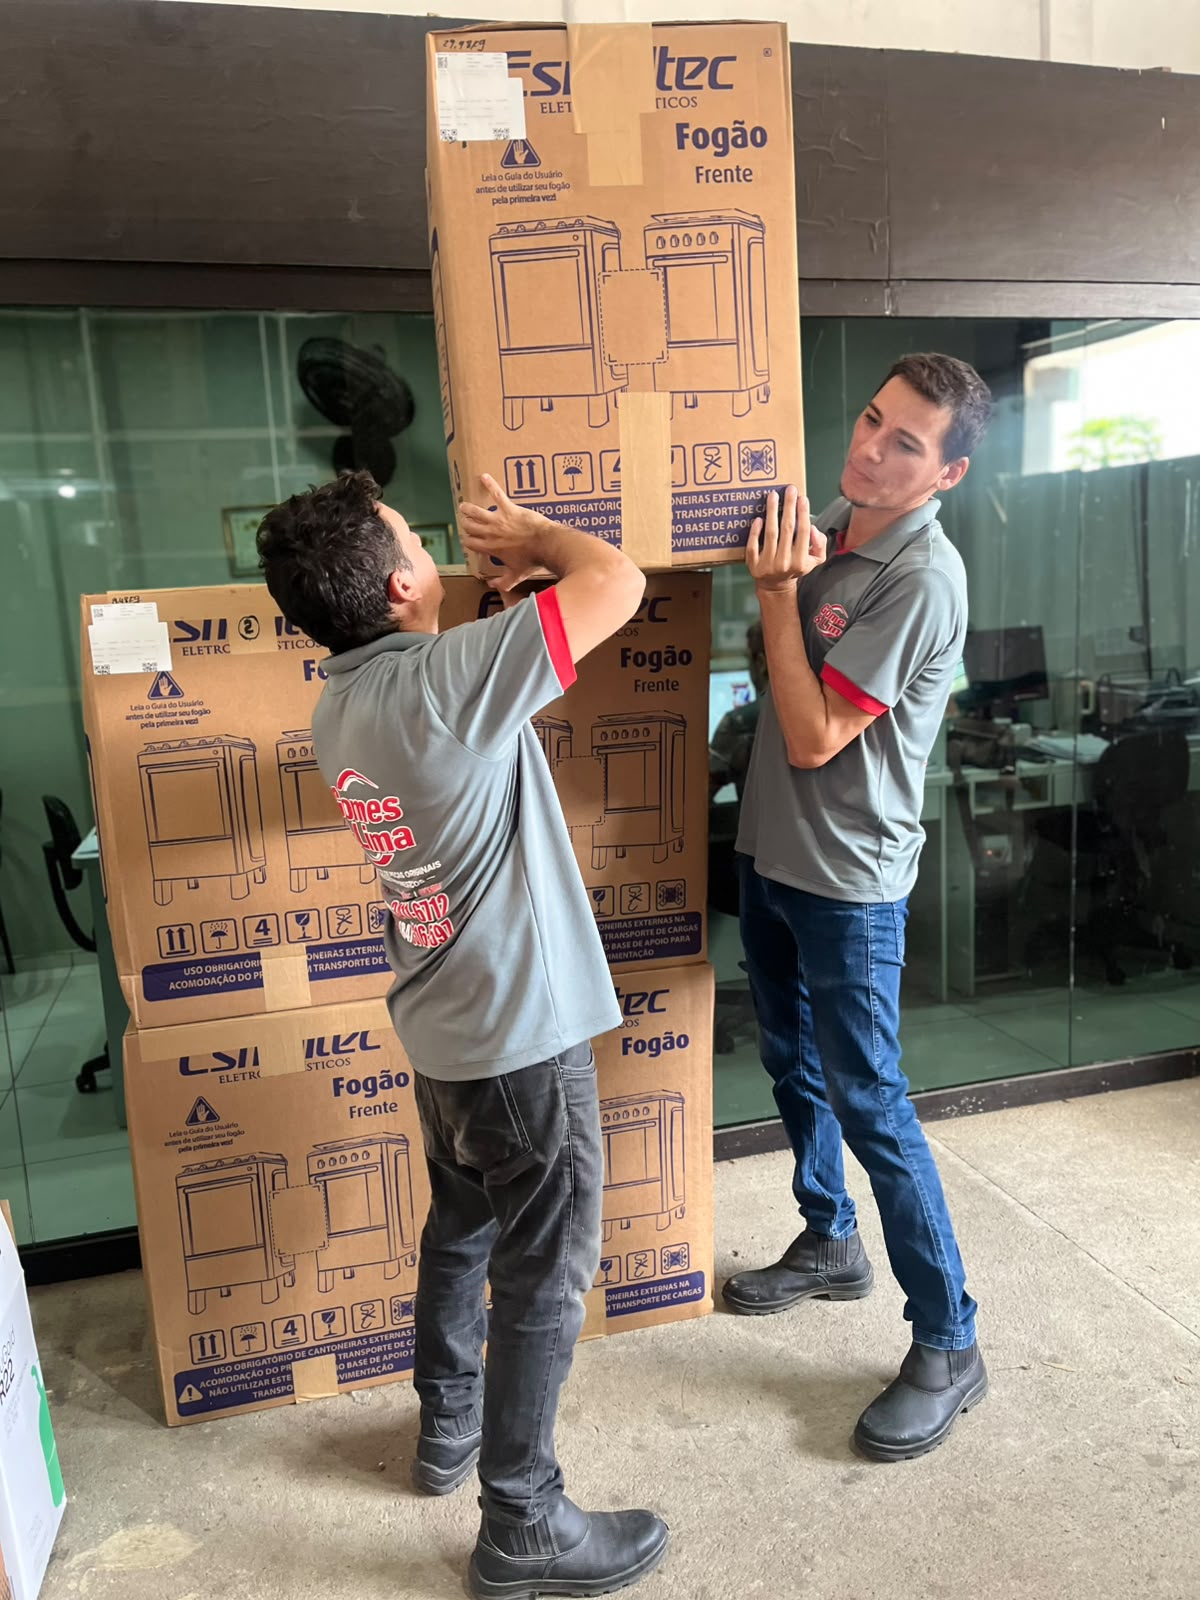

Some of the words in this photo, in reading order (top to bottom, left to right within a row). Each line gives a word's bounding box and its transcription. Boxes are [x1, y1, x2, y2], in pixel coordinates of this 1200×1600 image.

[675, 120, 768, 158] Fogão
[481, 174, 497, 182] Leia
[504, 172, 522, 181] Guia
[523, 171, 533, 180] do
[534, 170, 563, 179] Usuário
[695, 164, 753, 184] Frente
[475, 185, 496, 194] antes
[497, 184, 507, 193] de
[508, 183, 533, 192] utilizar
[534, 183, 548, 191] seu
[549, 181, 571, 191] fogão
[491, 195, 509, 206] pela
[509, 193, 541, 205] primeira
[712, 490, 761, 504] EXTERNAS
[591, 516, 607, 526] DO
[675, 505, 740, 520] TRANSPORTE
[741, 504, 754, 515] DE
[685, 521, 711, 533] BASE
[711, 521, 725, 531] DE
[620, 645, 693, 673] Fogão
[634, 678, 680, 693] Frente
[151, 702, 167, 710] Guia
[178, 699, 204, 708] Usuário
[125, 713, 144, 721] antes
[191, 708, 212, 717] fogão
[140, 721, 155, 730] pela
[156, 719, 185, 728] primeira
[334, 792, 404, 824] omes
[352, 824, 416, 853] Lima
[254, 918, 271, 936] 4
[599, 920, 633, 931] ONEIRAS
[634, 916, 673, 927] EXTERNAS
[674, 914, 686, 922] NA
[605, 928, 655, 940] TRANSPORTE
[656, 927, 667, 935] DE
[667, 923, 699, 934] CARGAS
[611, 941, 631, 951] BASE
[632, 940, 643, 948] DE
[644, 937, 669, 947] APOIO
[670, 934, 691, 944] PARA
[183, 966, 203, 976] USO
[204, 959, 261, 974] OBRIGATÓRI
[306, 948, 344, 961] ONEIRAS
[345, 944, 385, 957] EXTERNA
[168, 973, 236, 991] ACOMODAÇÃO
[237, 972, 252, 982] DO
[313, 959, 371, 972] TRANSPORTE
[371, 956, 384, 965] DE
[622, 1031, 690, 1058] Fogão
[332, 1069, 410, 1098] Fogão
[349, 1101, 399, 1119] Frente
[214, 1122, 239, 1131] Usuário
[178, 1145, 192, 1154] pela
[192, 1141, 220, 1151] primeira
[606, 1290, 639, 1302] ONEIRAS
[640, 1283, 678, 1296] EXTERNAS
[679, 1279, 690, 1288] NA
[612, 1295, 660, 1311] TRANSPORTE
[661, 1293, 672, 1301] DE
[672, 1286, 702, 1299] CARGAS
[282, 1319, 298, 1336] 4
[213, 1364, 232, 1375] USO
[233, 1353, 294, 1371] OBRIGATÓRIO
[295, 1350, 307, 1359] DE
[307, 1338, 368, 1356] CANTONEIRAS
[369, 1329, 412, 1344] EXTERNAS
[199, 1369, 264, 1389] ACOMODAÇÃO
[265, 1366, 279, 1375] DO
[338, 1343, 393, 1360] TRANSPORTE
[393, 1341, 406, 1349] DE
[208, 1386, 229, 1398] NÃO
[230, 1378, 270, 1393] UTILIZAR
[271, 1374, 292, 1384] ESTE
[346, 1358, 368, 1369] BASE
[369, 1356, 381, 1364] DE
[382, 1350, 409, 1362] APOIO
[252, 1384, 294, 1399] TRANSPO
